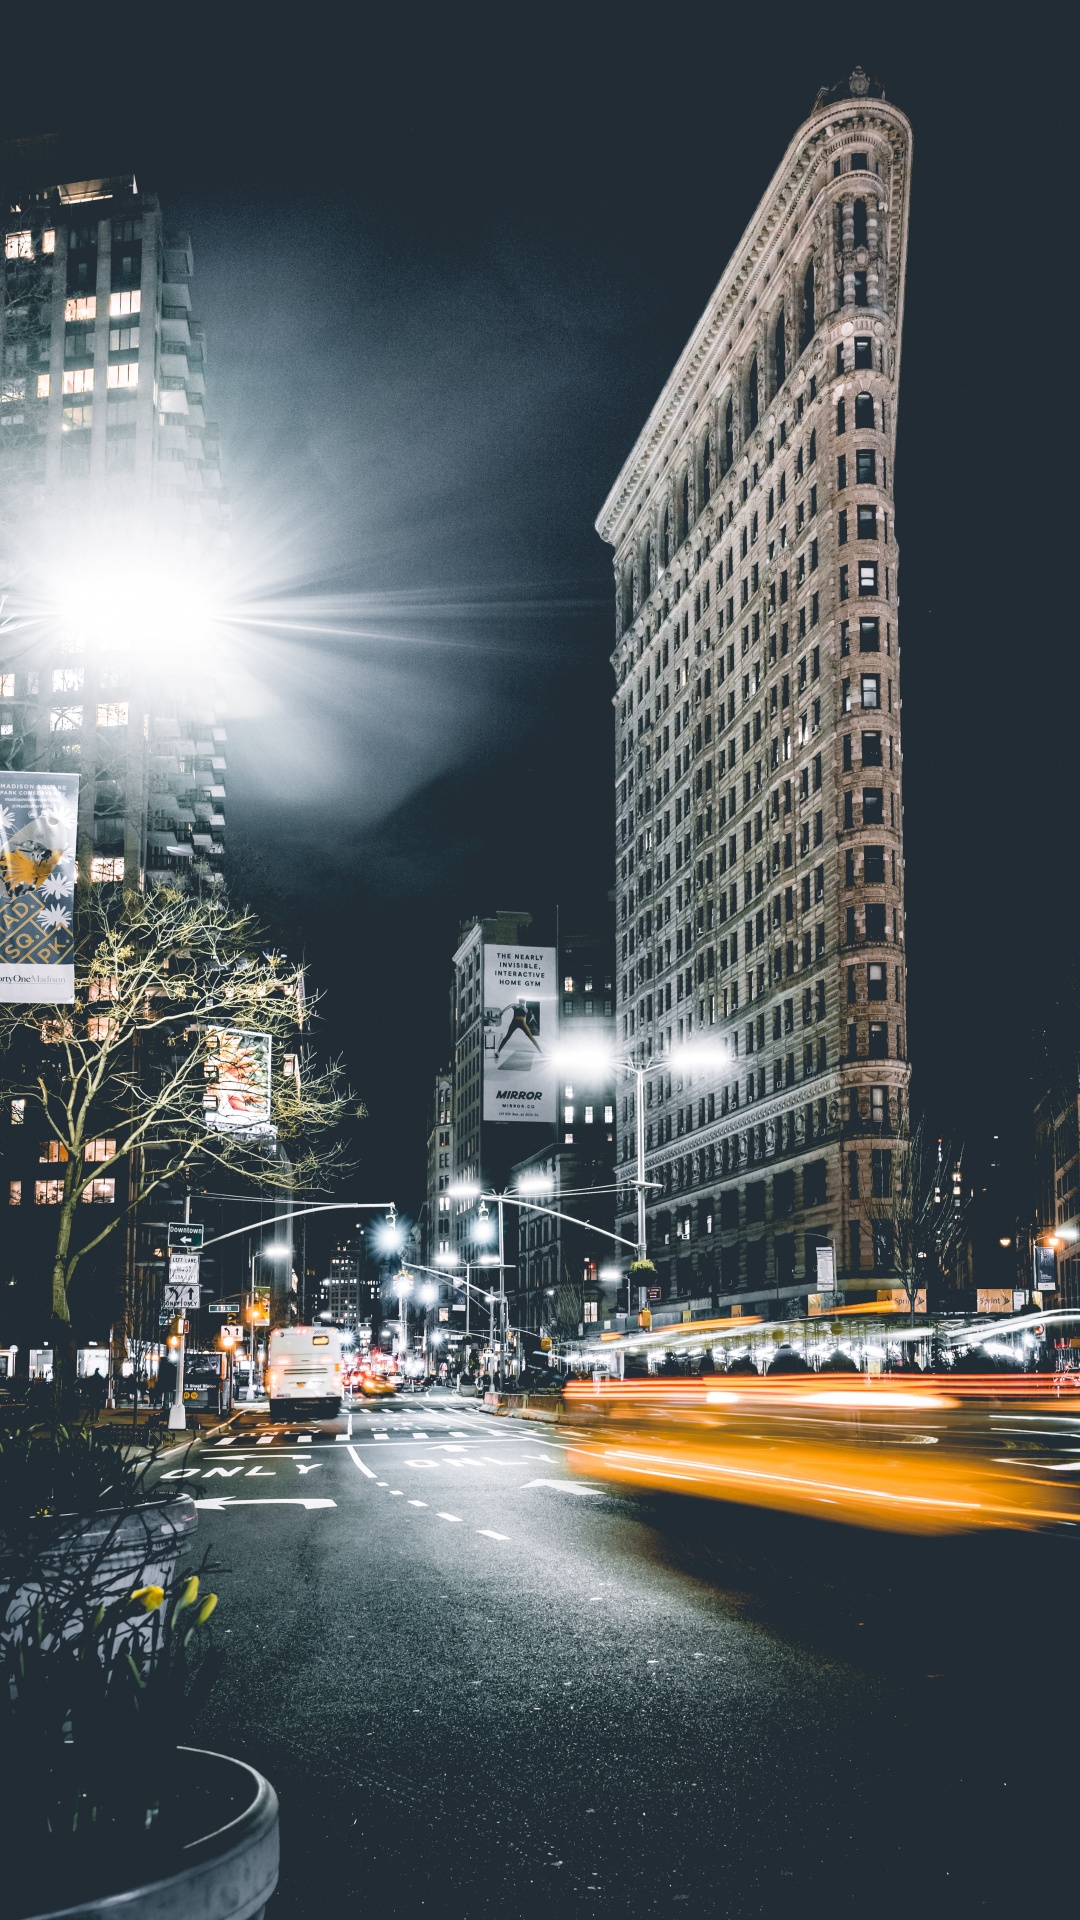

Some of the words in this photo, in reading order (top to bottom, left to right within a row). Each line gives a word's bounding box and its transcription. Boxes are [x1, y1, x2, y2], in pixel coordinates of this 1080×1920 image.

[0, 902, 36, 934] AD.
[5, 933, 40, 960] SQ.
[37, 936, 71, 964] PK.
[496, 952, 512, 960] THE
[514, 953, 544, 961] NEARLY
[499, 961, 541, 970] INVISIBLE,
[494, 970, 545, 979] INTERACTIVE
[496, 1090, 543, 1101] MIRROR
[170, 1226, 202, 1234] Downtown
[979, 1297, 1001, 1306] Sprint
[403, 1454, 560, 1468] ONLY
[160, 1463, 323, 1479] ONLY
